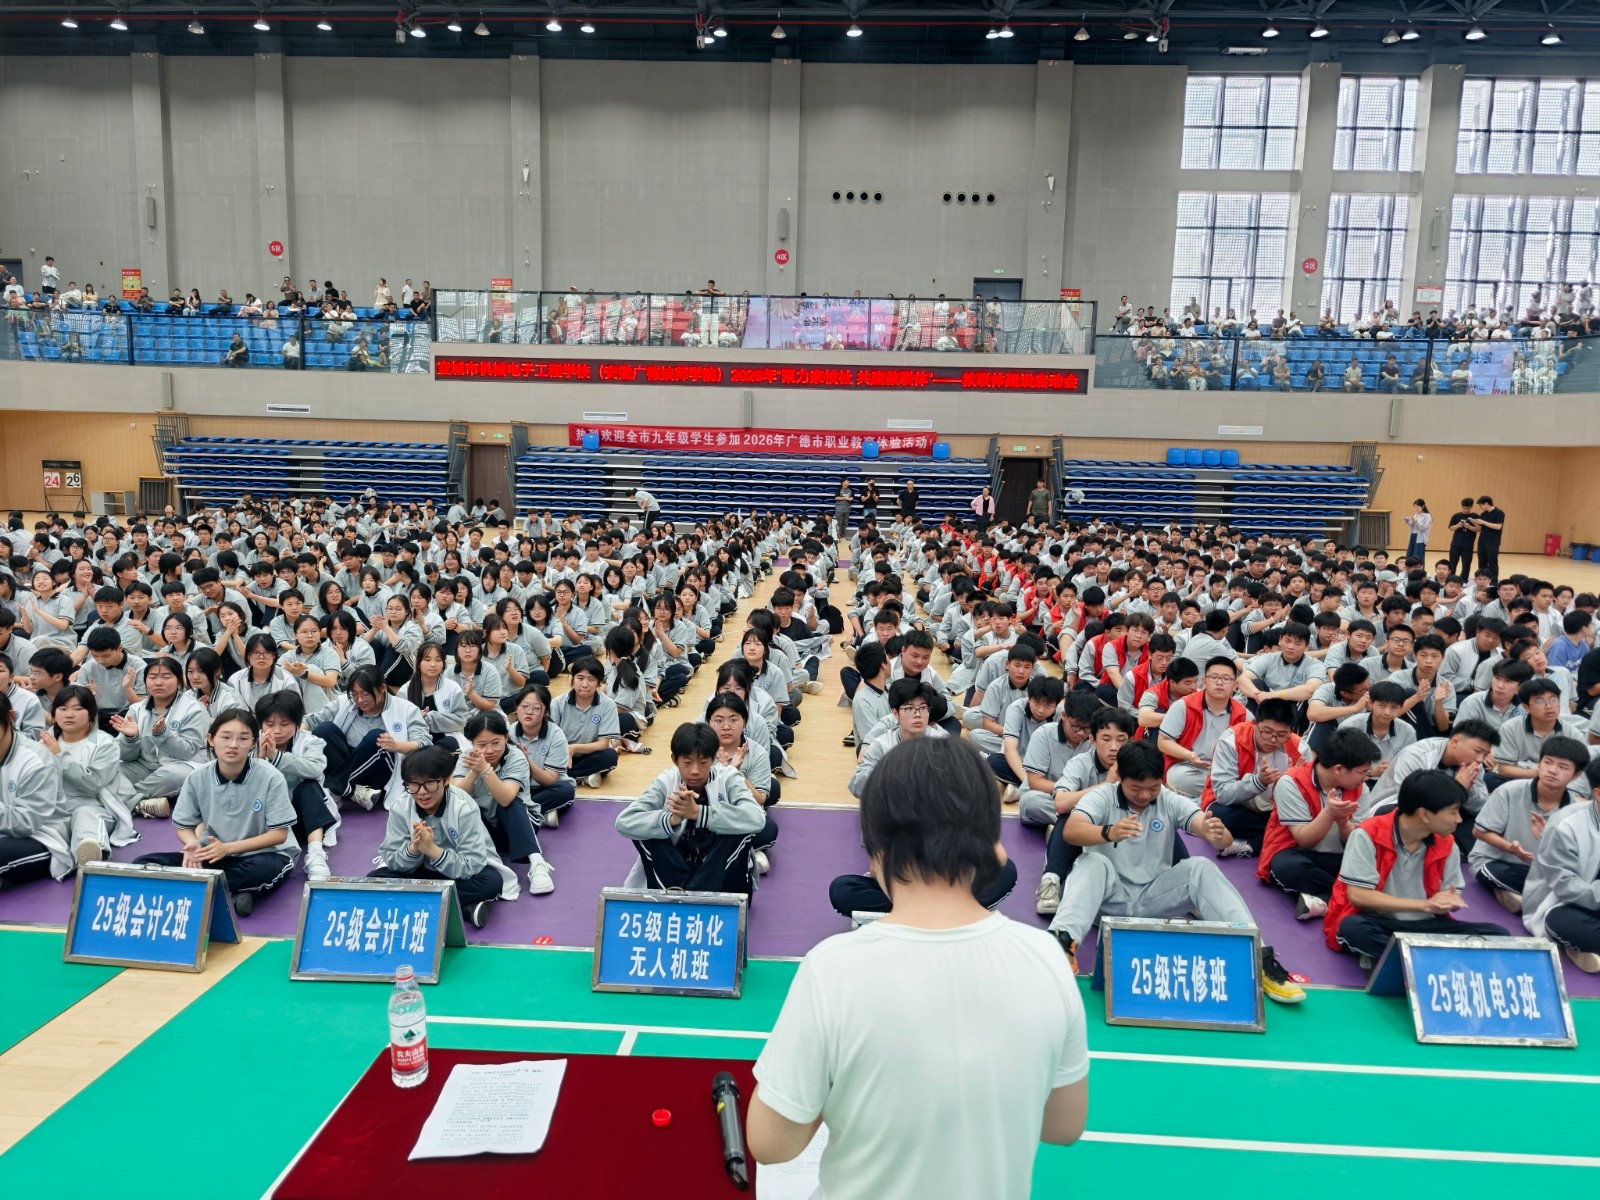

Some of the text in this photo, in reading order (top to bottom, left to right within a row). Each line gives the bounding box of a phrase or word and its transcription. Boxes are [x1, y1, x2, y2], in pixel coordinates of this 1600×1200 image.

[776, 253, 787, 261] 4区
[1304, 261, 1316, 270] 3区
[45, 476, 60, 487] 24
[91, 892, 192, 941] 25级会计2班
[323, 906, 429, 955] 25级会计1班
[618, 911, 724, 947] 25级自动化
[628, 946, 710, 980] 无人机班
[1131, 954, 1228, 1003] 25级汽修班
[1427, 970, 1541, 1021] 25级机电3班
